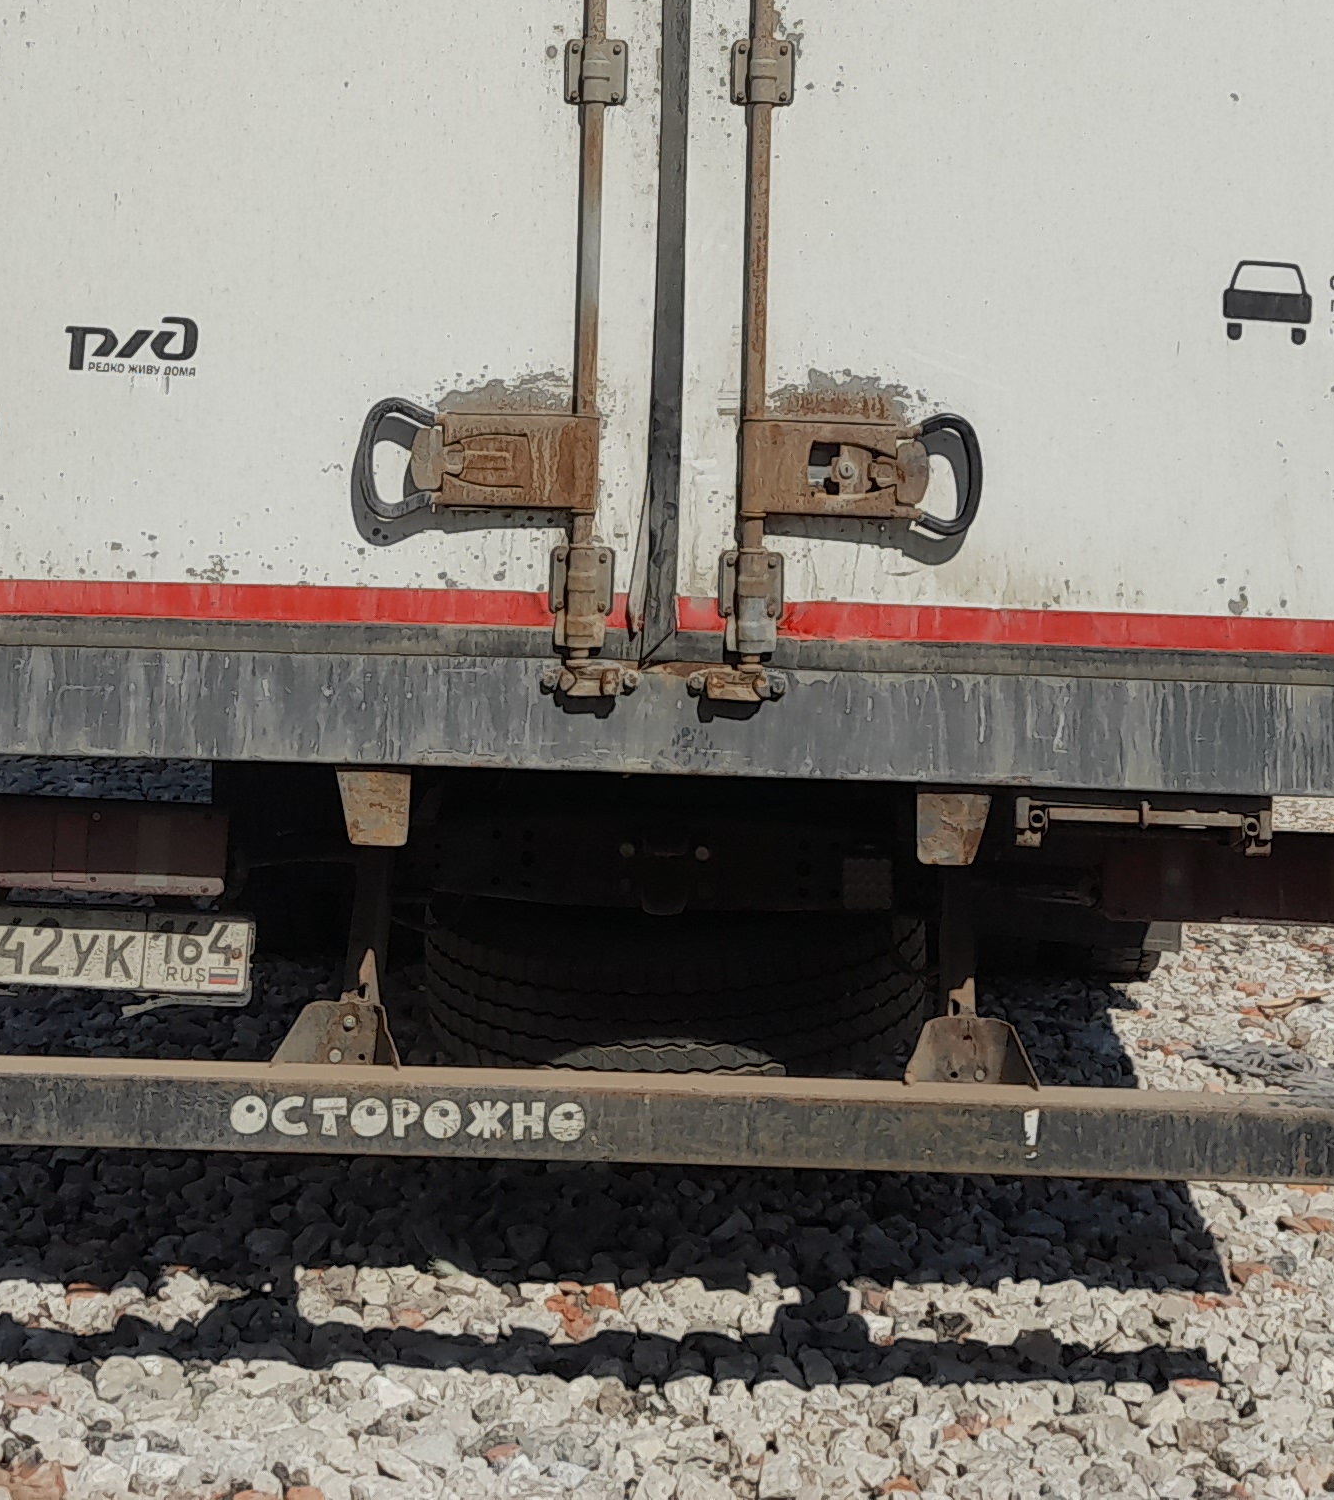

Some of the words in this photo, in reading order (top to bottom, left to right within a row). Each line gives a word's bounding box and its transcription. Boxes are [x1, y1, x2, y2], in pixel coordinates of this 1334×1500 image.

[88, 361, 125, 373] РЕДКО
[127, 363, 161, 375] ЖИВУ
[163, 365, 196, 377] ДОМА
[155, 920, 233, 967] 164
[167, 966, 207, 983] RUS
[229, 1094, 587, 1143] ОСТОРОЖНО
